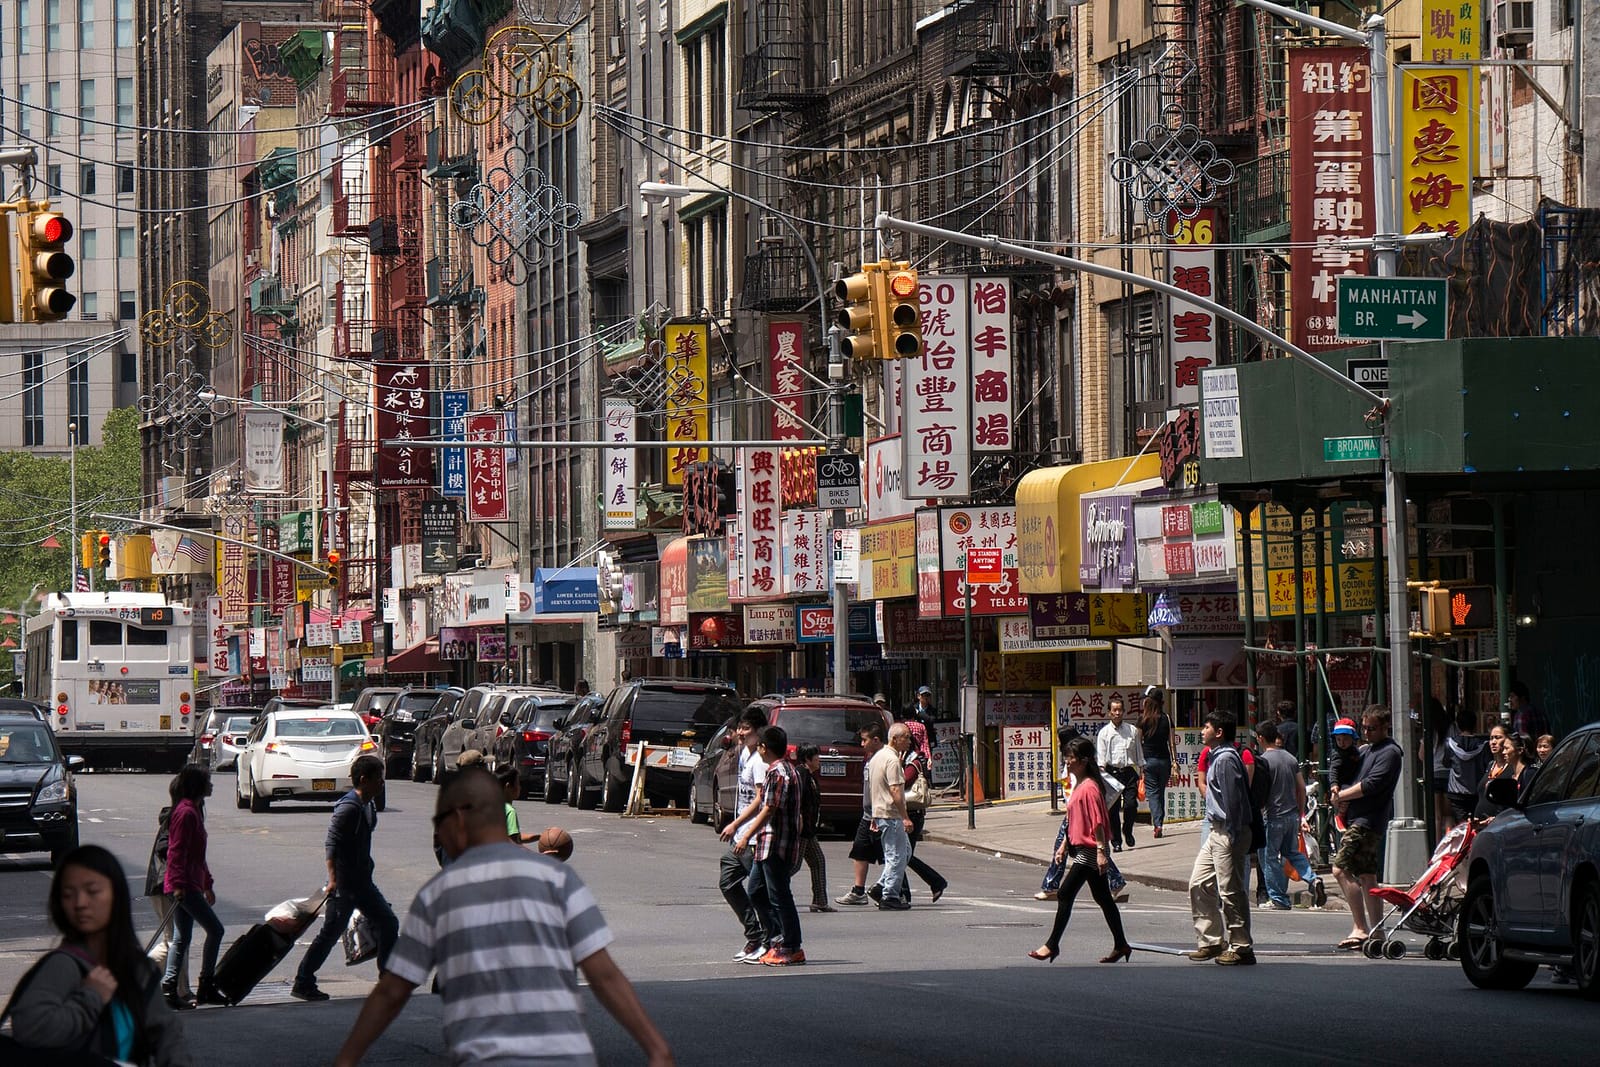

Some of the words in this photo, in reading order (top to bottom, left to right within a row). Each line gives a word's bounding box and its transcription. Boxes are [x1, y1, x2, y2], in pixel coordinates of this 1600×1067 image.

[1302, 61, 1370, 94] 紐約
[1173, 219, 1213, 245] 66
[1348, 288, 1437, 305] MANHATTAN
[1355, 311, 1378, 327] BR.
[1361, 368, 1386, 381] ONE
[384, 388, 425, 409] 永昌
[1184, 462, 1199, 486] 66
[382, 478, 402, 486] Universal
[403, 477, 419, 486] Optical
[819, 478, 835, 487] BIKE
[838, 477, 858, 486] LANE
[829, 489, 850, 498] BIKES
[830, 497, 849, 506] ONLY
[990, 597, 1007, 607] TEL
[1008, 597, 1016, 607] &
[119, 610, 140, 620] 6731
[750, 609, 776, 621] Lung
[1058, 708, 1069, 726] 64
